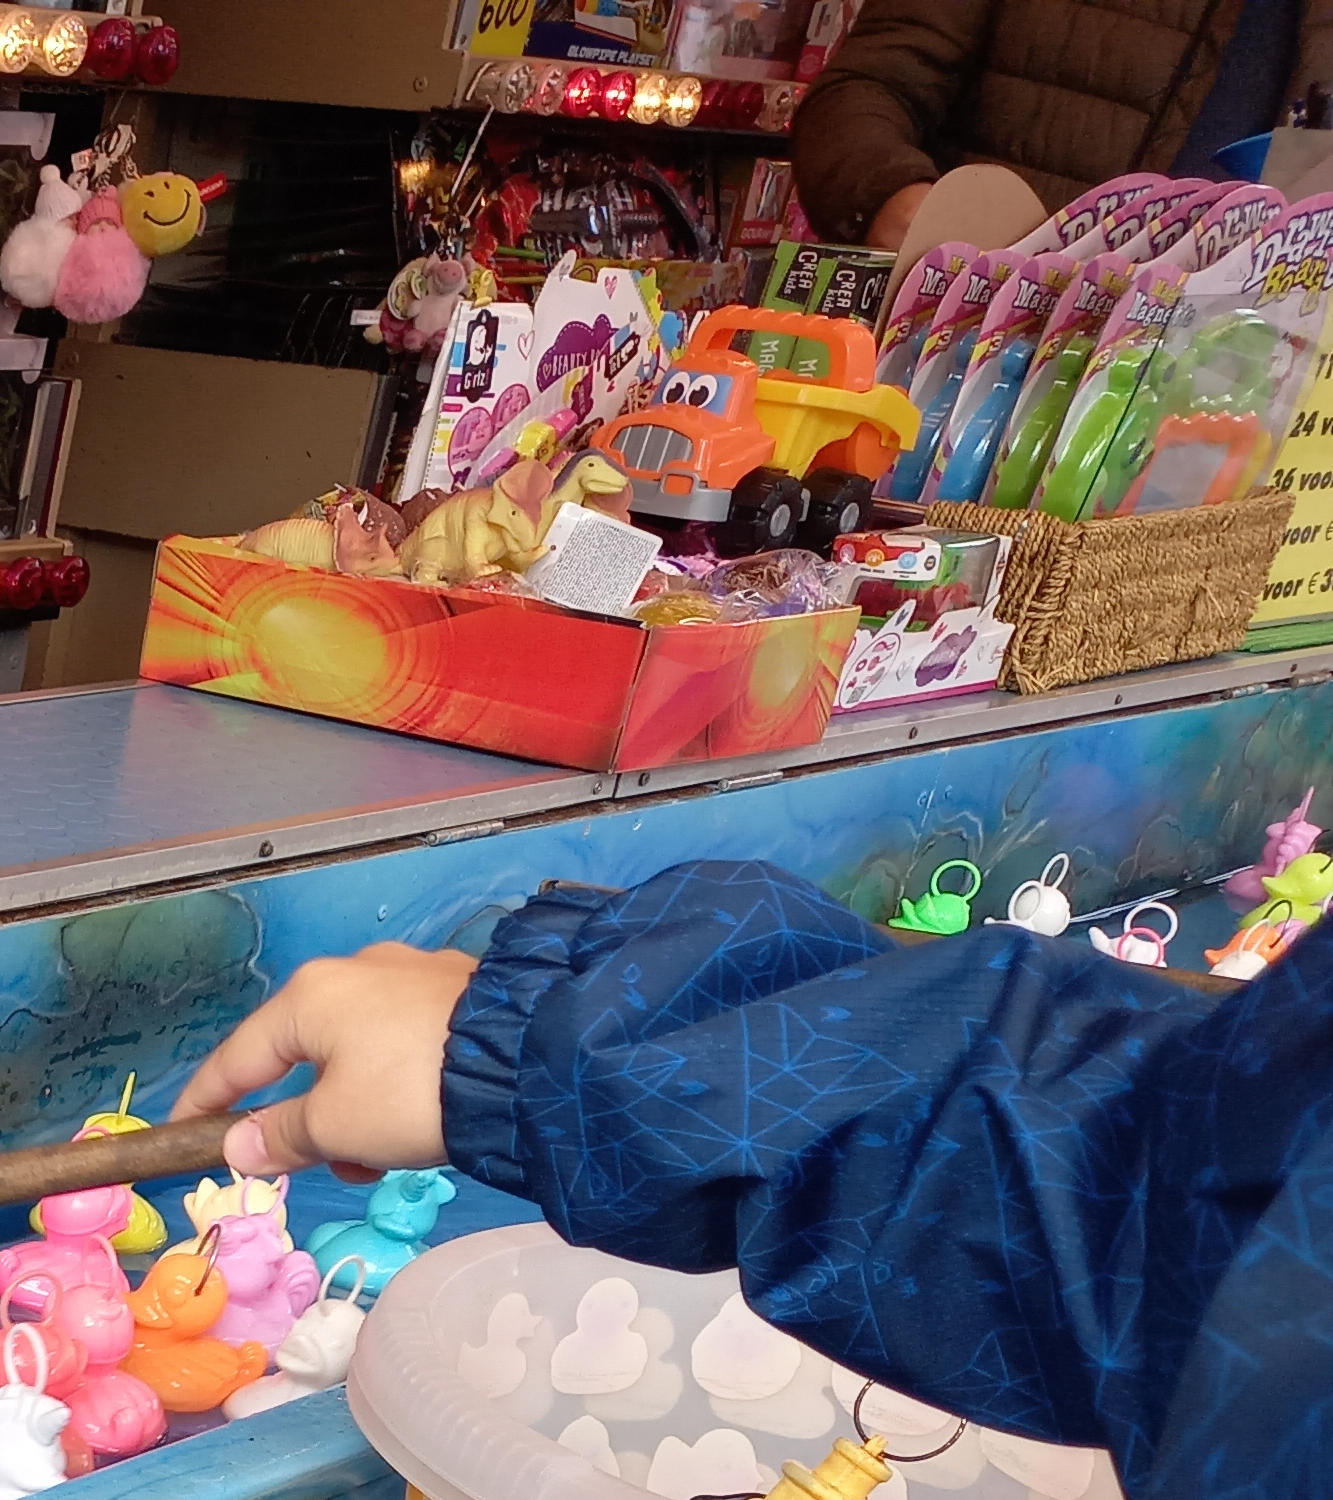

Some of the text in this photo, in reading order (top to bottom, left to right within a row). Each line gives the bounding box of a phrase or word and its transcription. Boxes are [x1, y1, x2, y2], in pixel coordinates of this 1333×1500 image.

[567, 45, 660, 68] BLOWPIPE PLAYSET
[783, 270, 797, 295] kids
[798, 250, 818, 290] CREA
[918, 265, 946, 296] Ma
[836, 269, 857, 309] CREA
[962, 271, 990, 305] Ma
[820, 288, 834, 314] kids
[551, 351, 589, 376] BEAUTY
[1288, 410, 1320, 438] 24
[1273, 467, 1298, 492] 36
[1281, 524, 1323, 547] voor
[1262, 578, 1305, 602] voor
